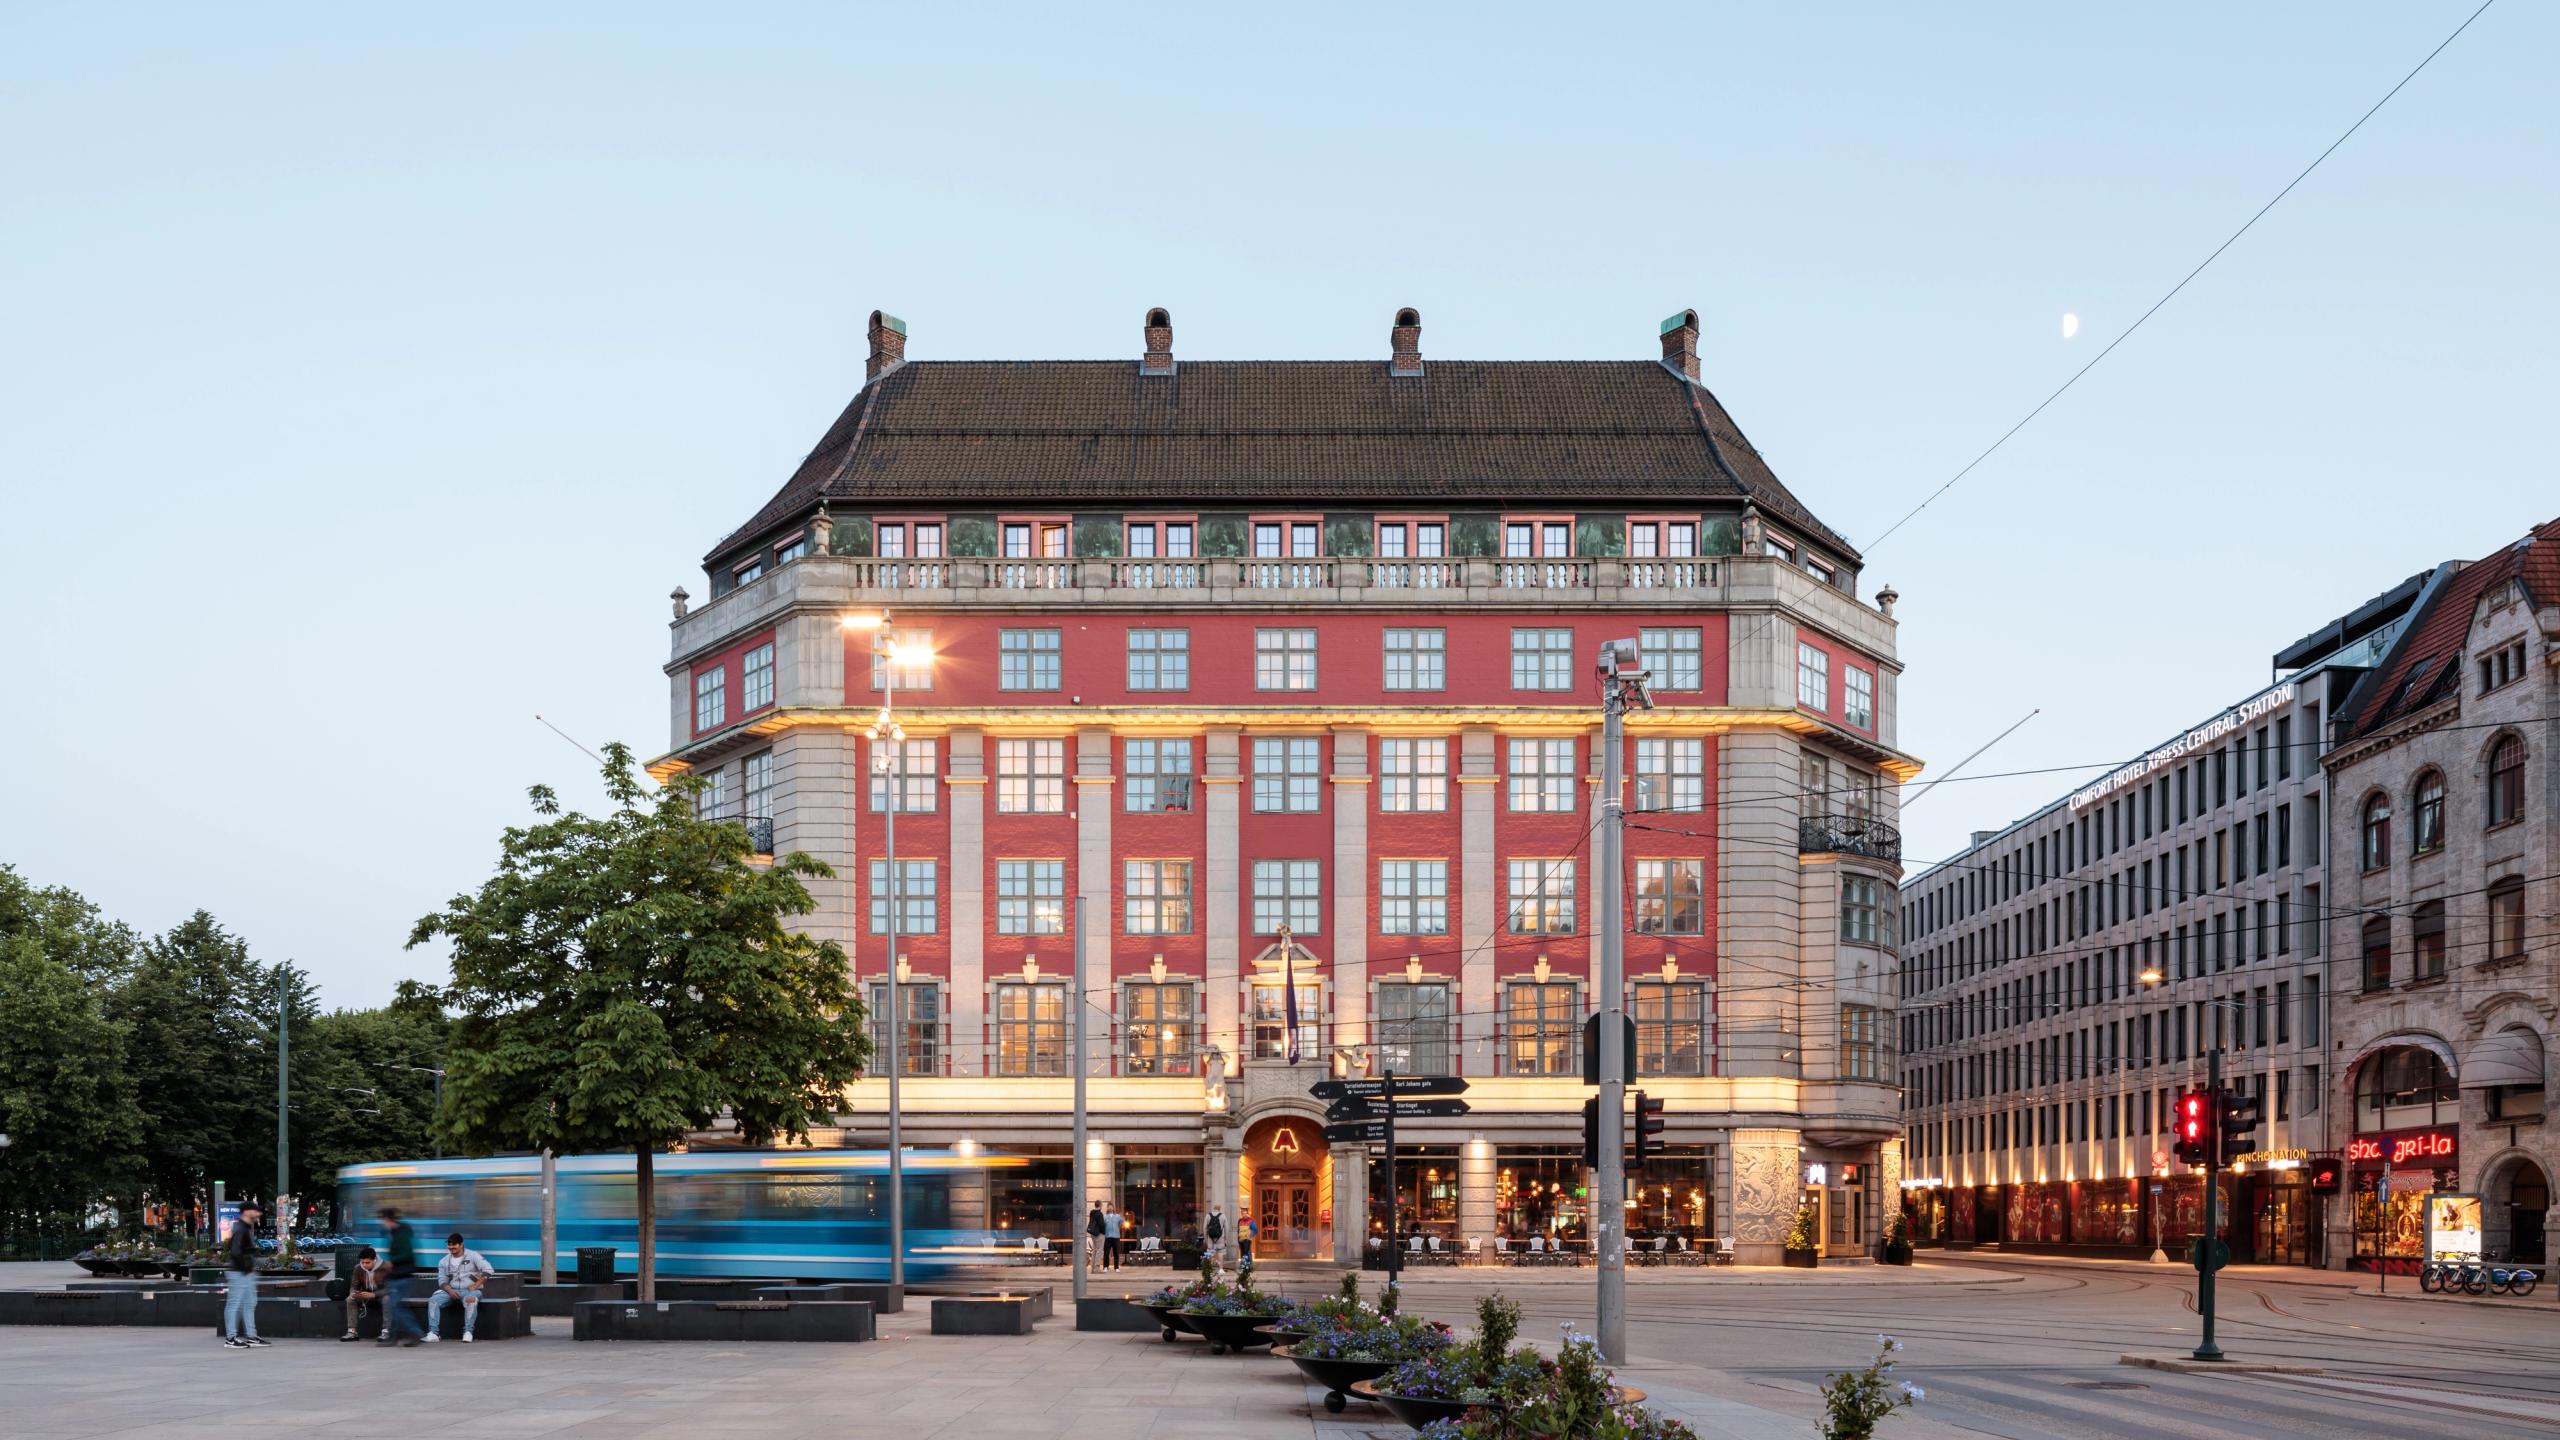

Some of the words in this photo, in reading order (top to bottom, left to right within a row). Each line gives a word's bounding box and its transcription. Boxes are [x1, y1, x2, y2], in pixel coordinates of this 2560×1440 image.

[2068, 778, 2114, 811] COMFORT
[2113, 765, 2147, 790] HOTEL
[2147, 740, 2184, 773] XPRESS
[2186, 716, 2237, 751] CENTRAL
[2239, 684, 2292, 725] STATION
[1272, 1128, 1299, 1152] A
